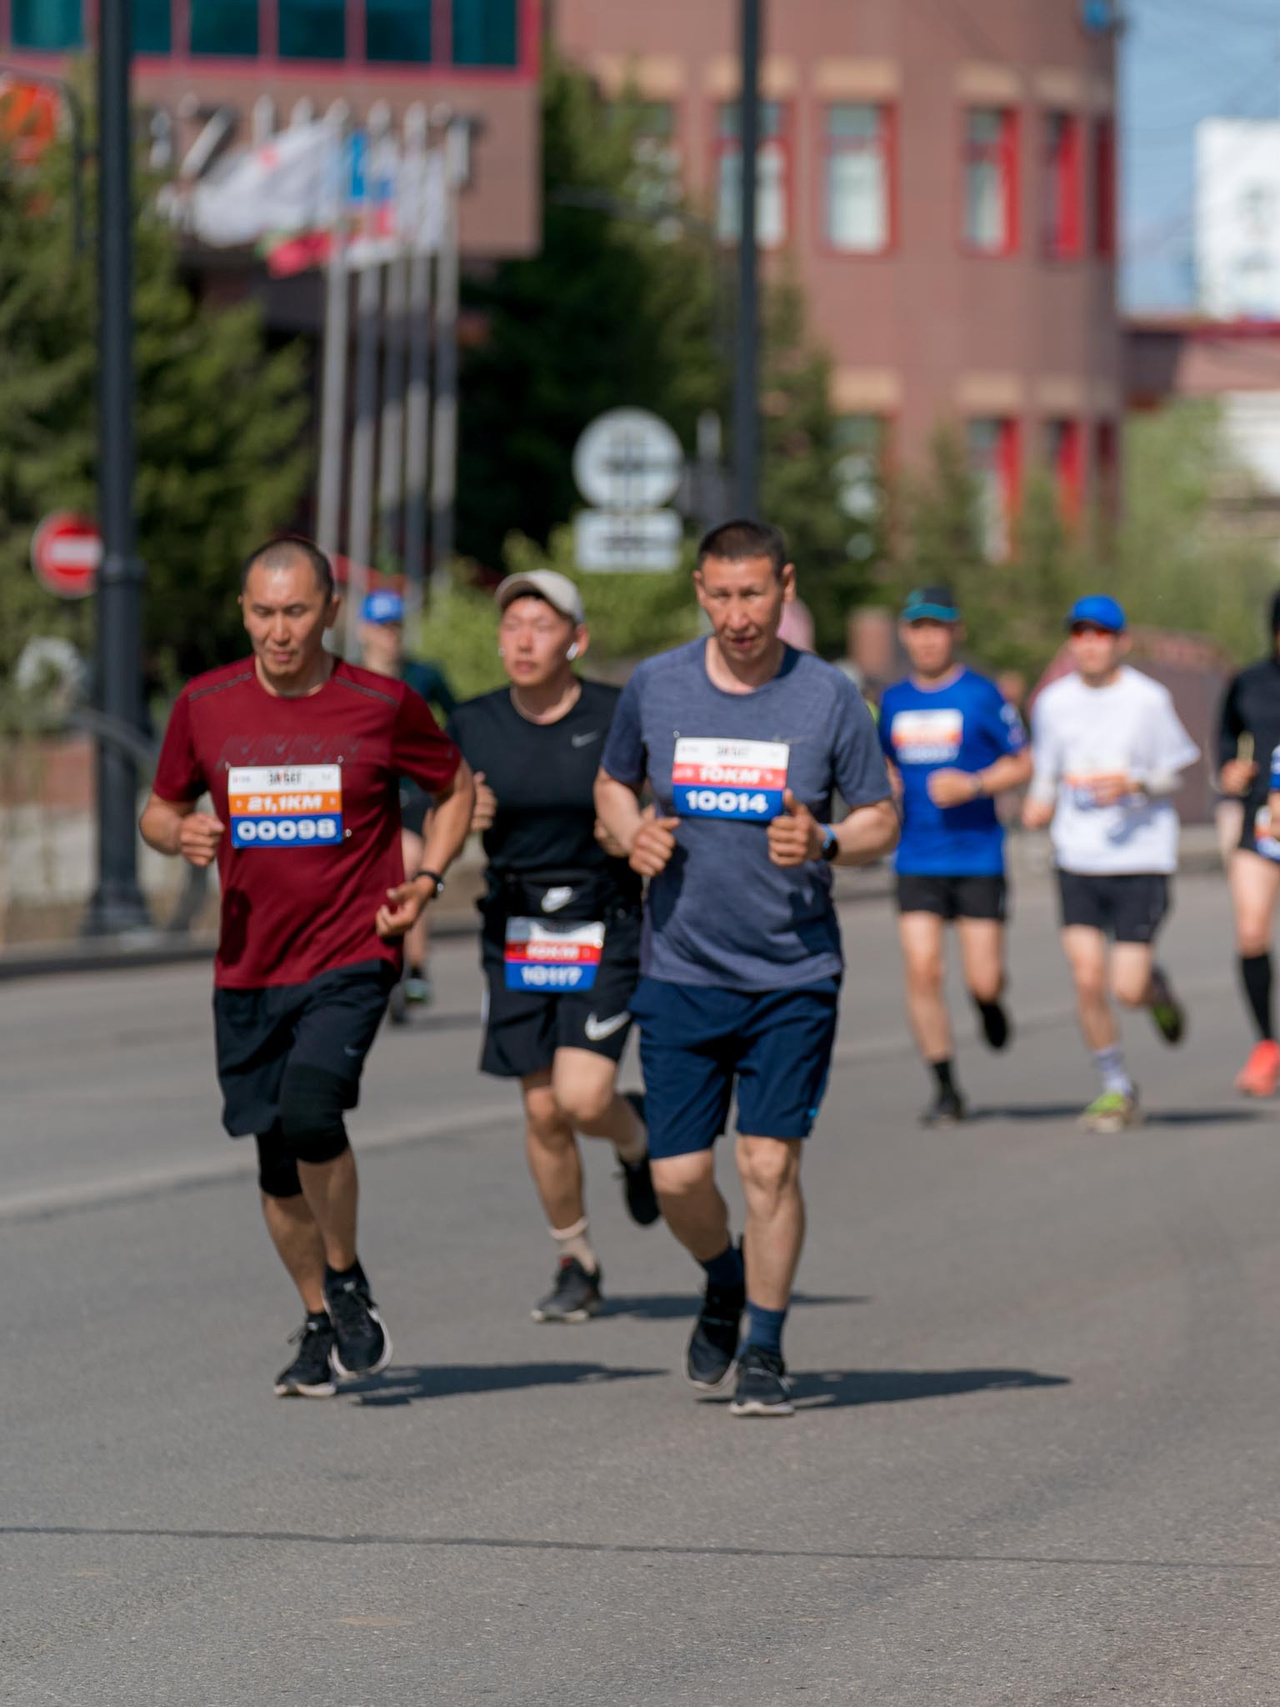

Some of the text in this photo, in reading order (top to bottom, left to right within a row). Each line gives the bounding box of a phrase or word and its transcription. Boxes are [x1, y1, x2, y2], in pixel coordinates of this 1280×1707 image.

[685, 790, 769, 814] 10014
[237, 818, 337, 841] 00098
[521, 965, 583, 986] 10117
